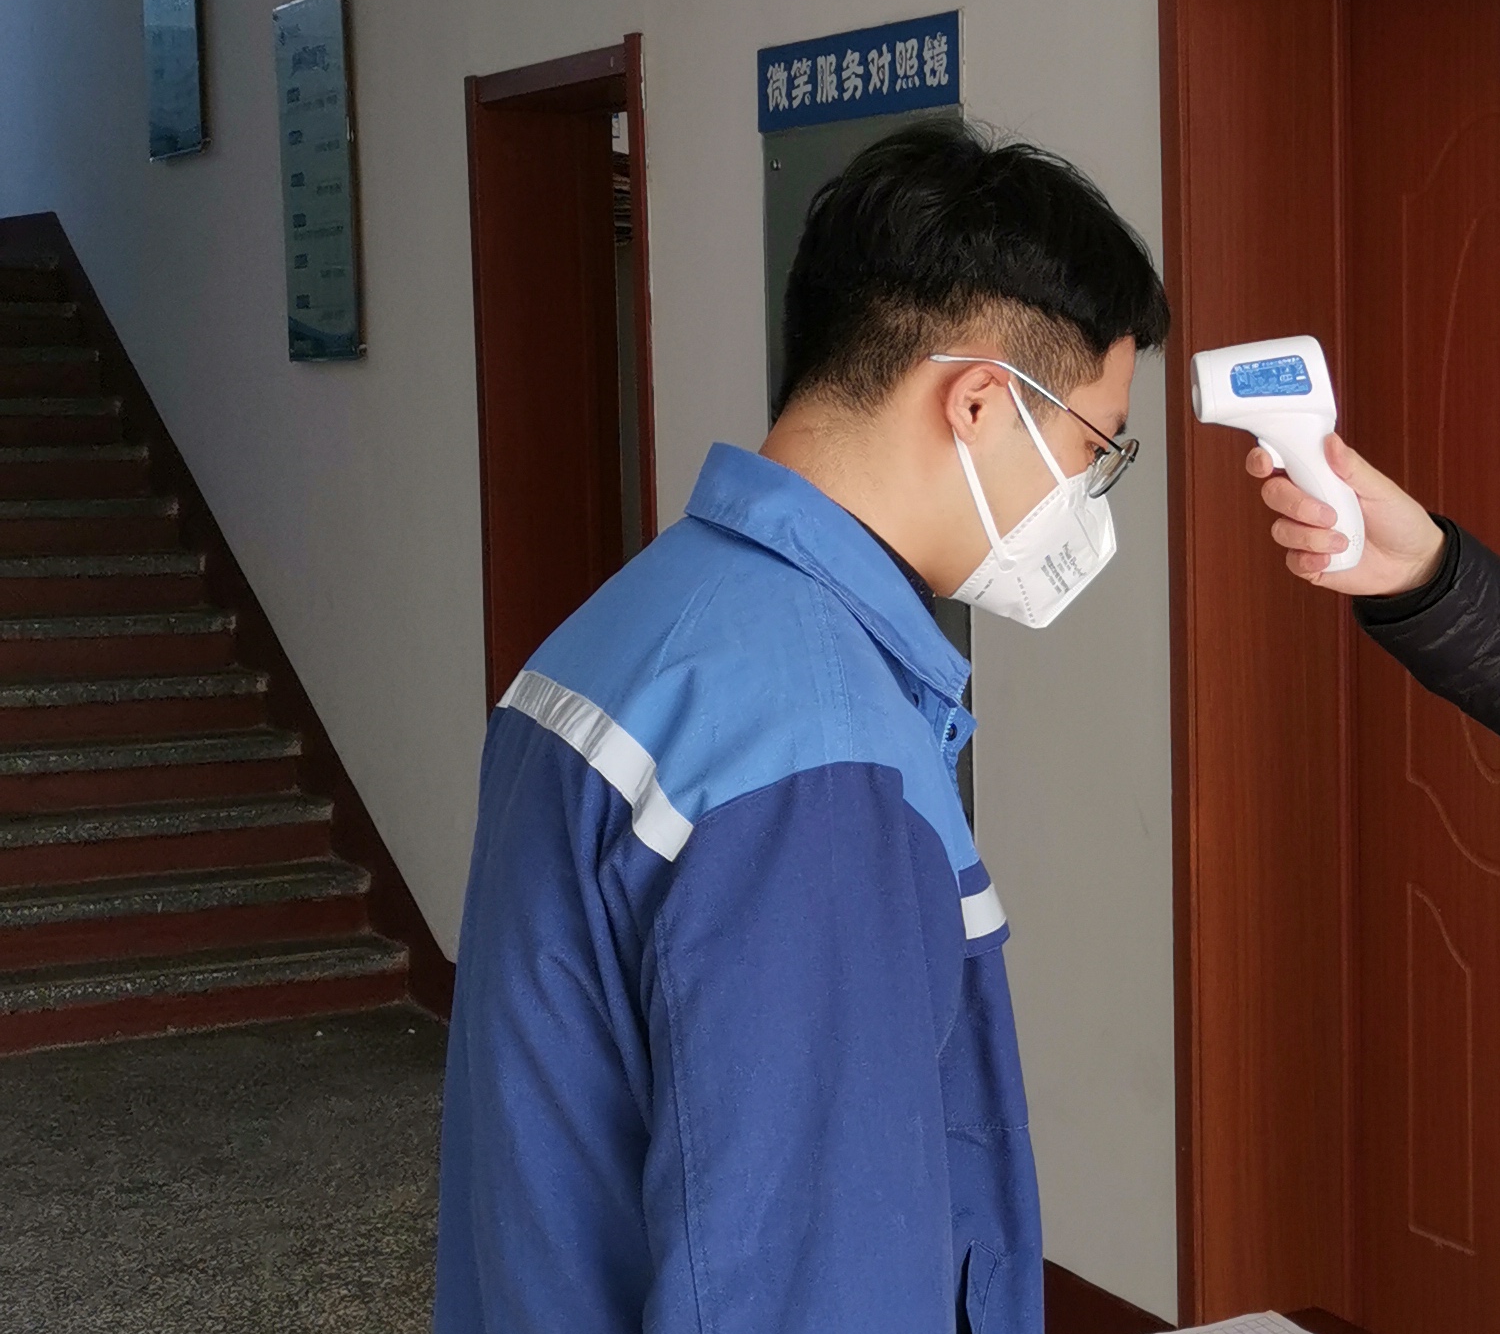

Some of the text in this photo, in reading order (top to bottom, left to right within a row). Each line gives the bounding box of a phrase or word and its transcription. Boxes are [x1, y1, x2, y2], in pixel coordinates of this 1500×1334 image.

[766, 31, 950, 114] 微笑服务对照镜
